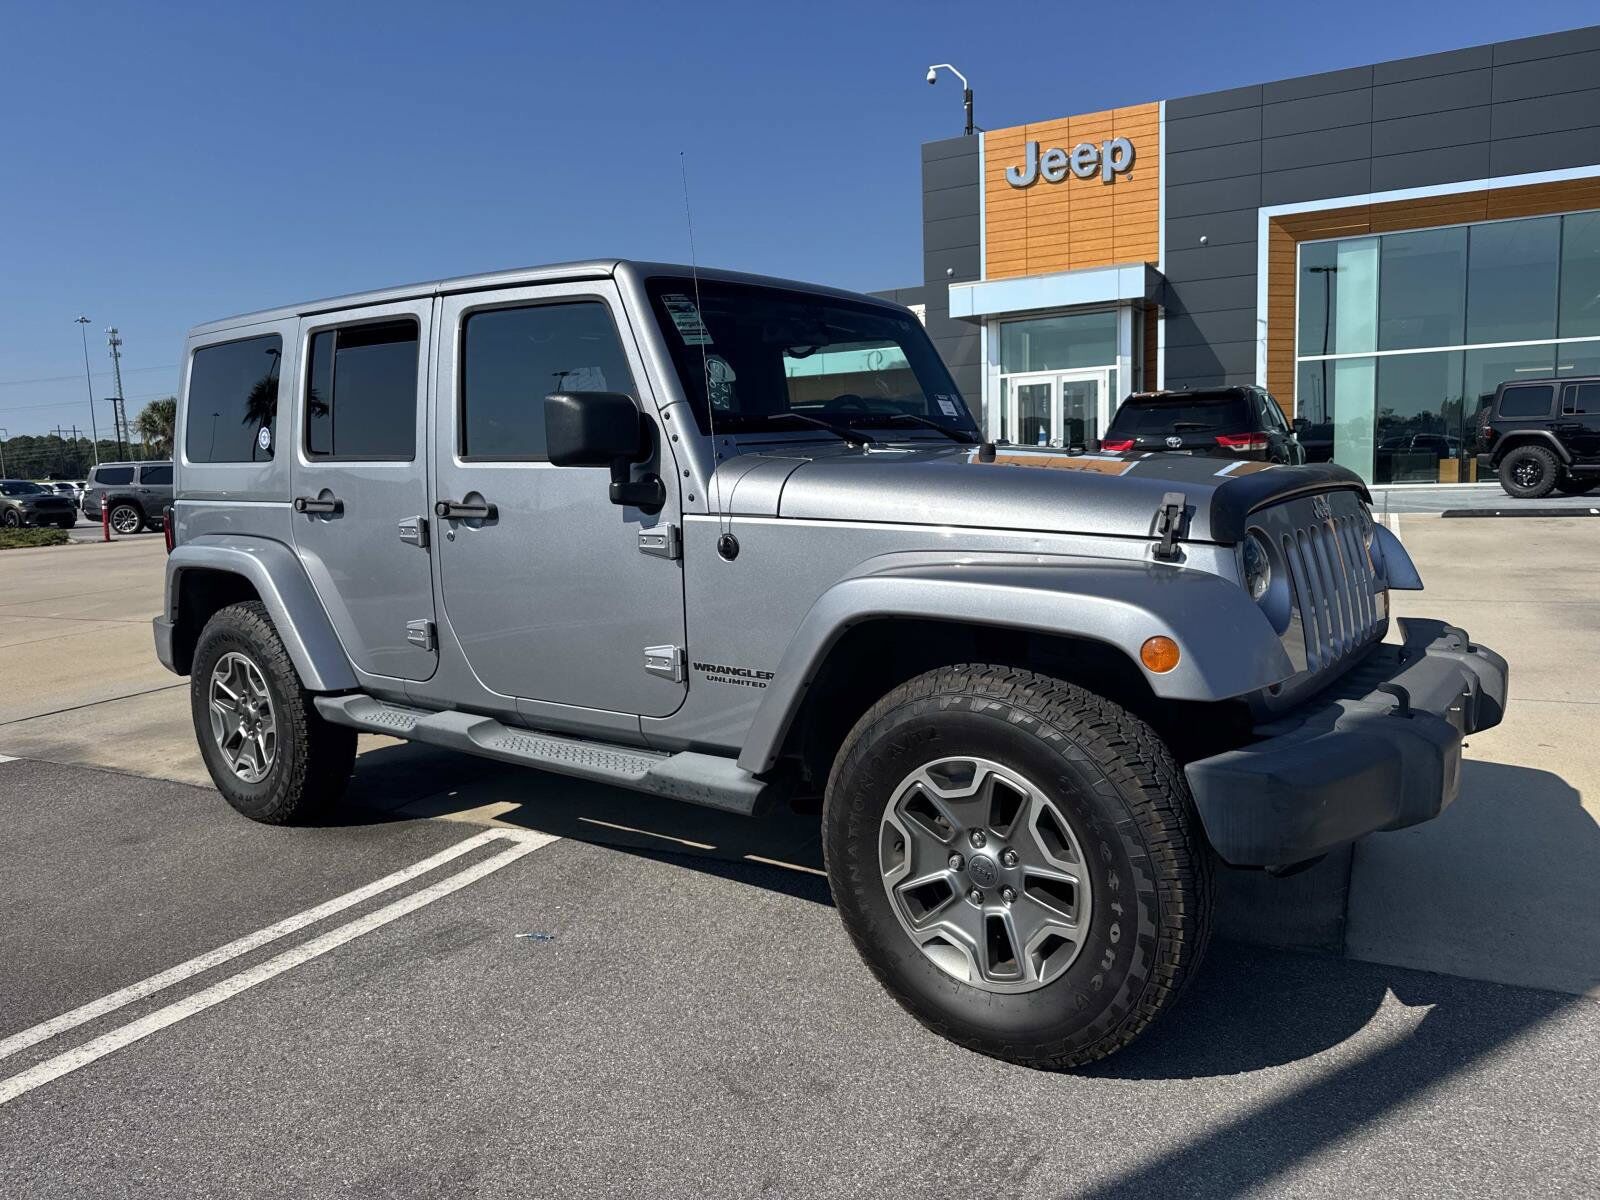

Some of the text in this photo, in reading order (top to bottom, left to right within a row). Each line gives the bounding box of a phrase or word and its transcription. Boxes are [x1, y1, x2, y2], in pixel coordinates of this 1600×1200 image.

[1006, 137, 1136, 189] Jeep
[693, 662, 775, 680] WRANGLER
[706, 675, 767, 689] UNLIMITED
[1056, 775, 1124, 991] estone
